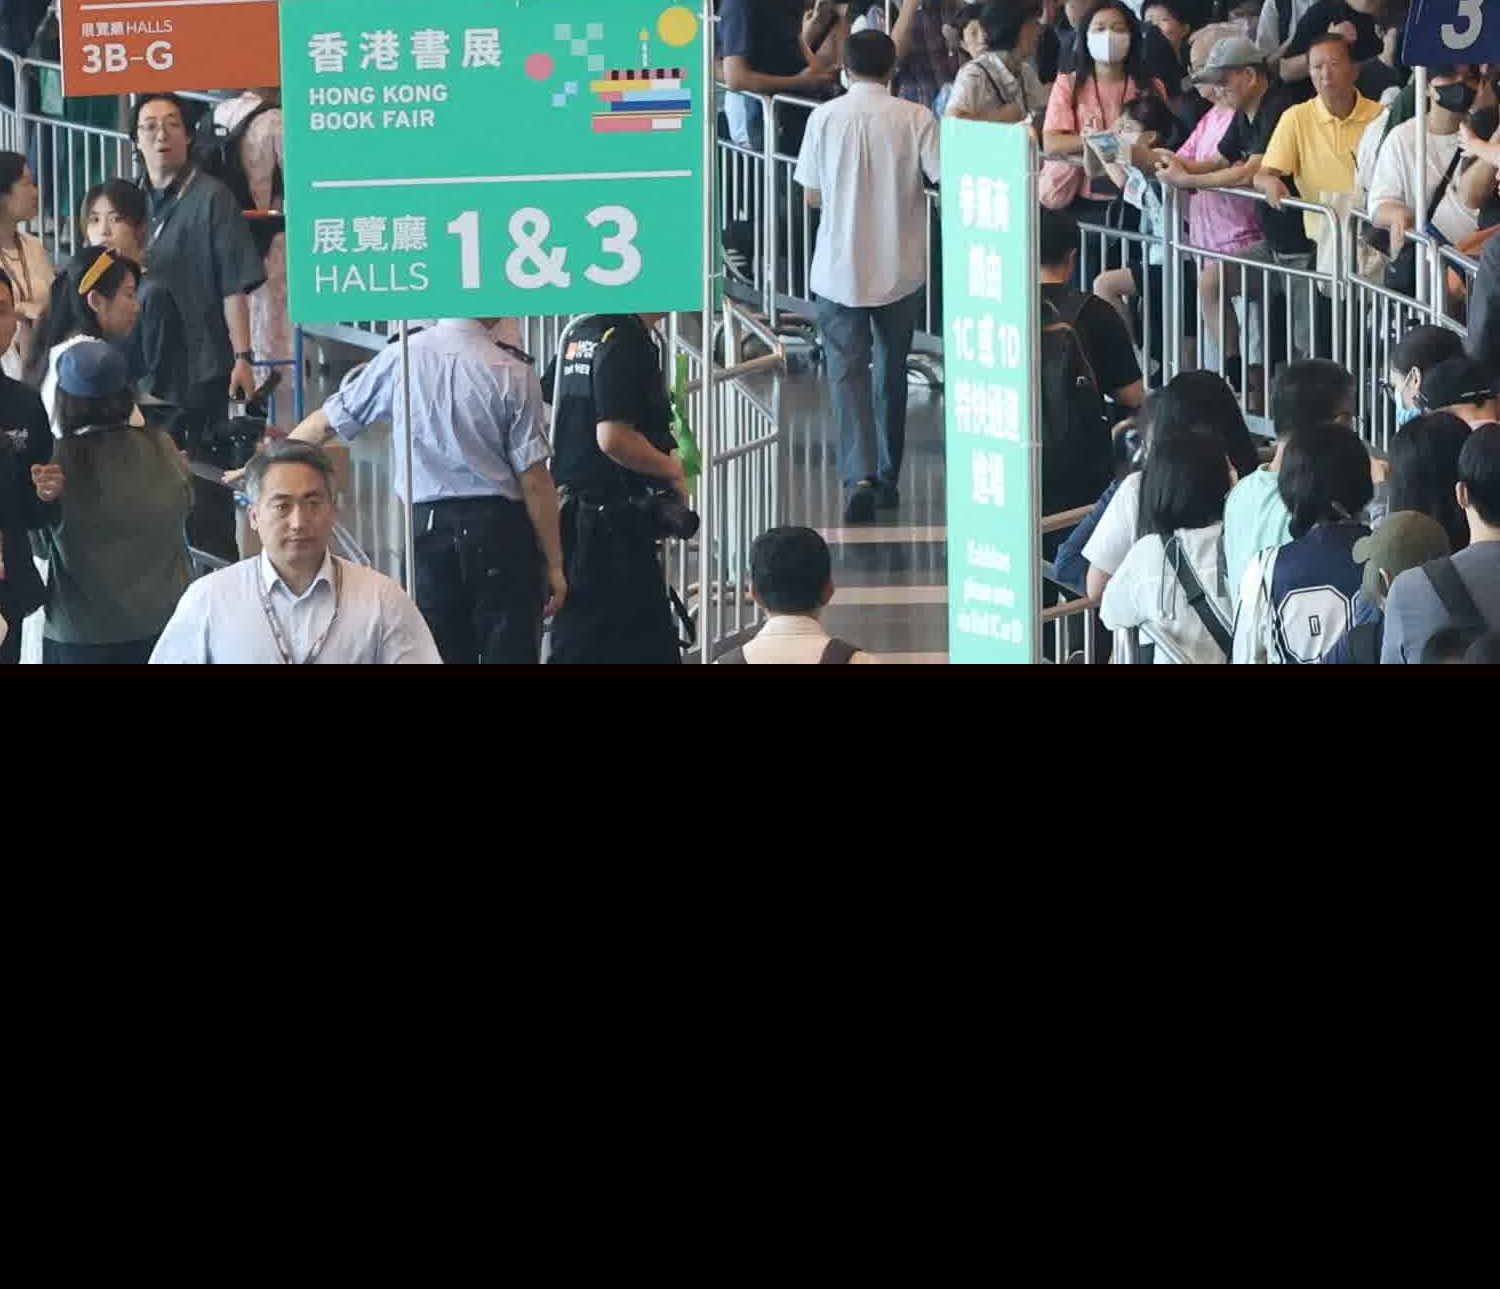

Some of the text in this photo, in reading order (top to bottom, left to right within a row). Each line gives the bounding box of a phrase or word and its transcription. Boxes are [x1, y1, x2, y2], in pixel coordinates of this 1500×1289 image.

[126, 19, 173, 34] HALLS
[81, 40, 174, 73] 3B-G
[307, 27, 504, 74] 香港書展
[308, 84, 448, 107] HONG KONG
[309, 109, 437, 131] BOOK FAIR
[310, 215, 430, 254] 展覽廳
[314, 262, 430, 294] HALLS
